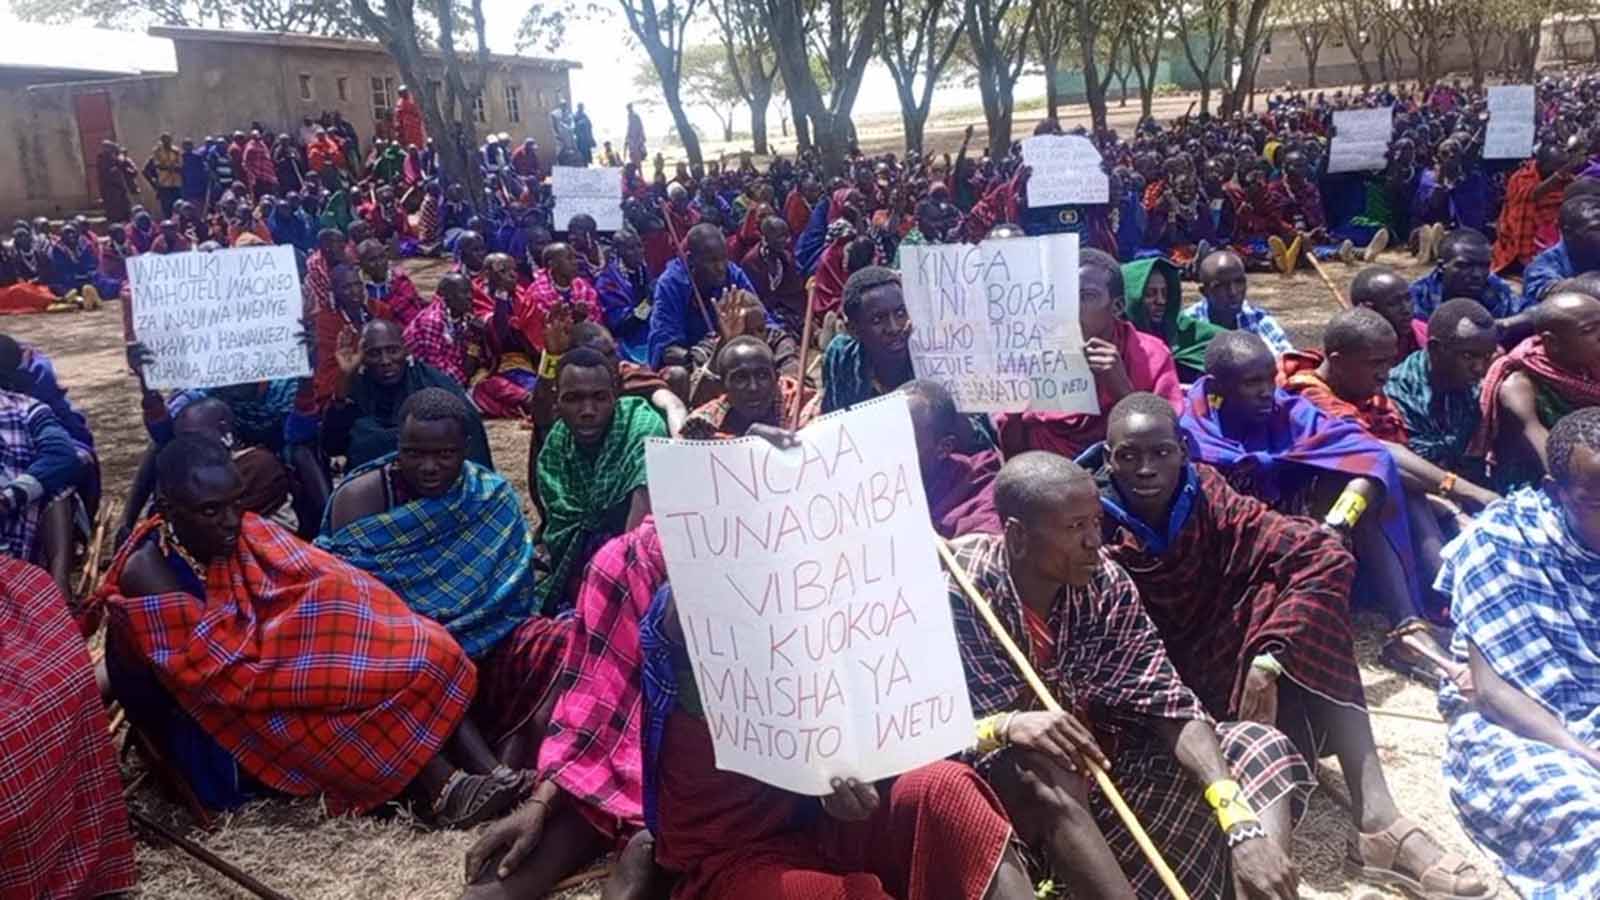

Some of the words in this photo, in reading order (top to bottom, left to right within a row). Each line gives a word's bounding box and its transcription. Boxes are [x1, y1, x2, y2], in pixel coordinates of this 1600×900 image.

[240, 251, 277, 275] WA
[917, 247, 1011, 286] KINGA
[940, 287, 966, 320] NI
[987, 281, 1056, 321] BORA
[990, 321, 1044, 350] TIBA
[996, 349, 1068, 375] MAAFA
[976, 377, 1057, 402] WATOTO
[1062, 378, 1088, 395] WETU
[710, 423, 864, 505] NCAA
[666, 464, 912, 558] TUNAOMBA
[725, 536, 896, 616] VIBALI
[688, 614, 740, 661] ILI
[769, 587, 918, 671] KUOKOA
[699, 660, 846, 721] MAISHA
[861, 648, 913, 706] YA
[707, 704, 843, 764] WATOTO
[875, 694, 956, 750] WETU
